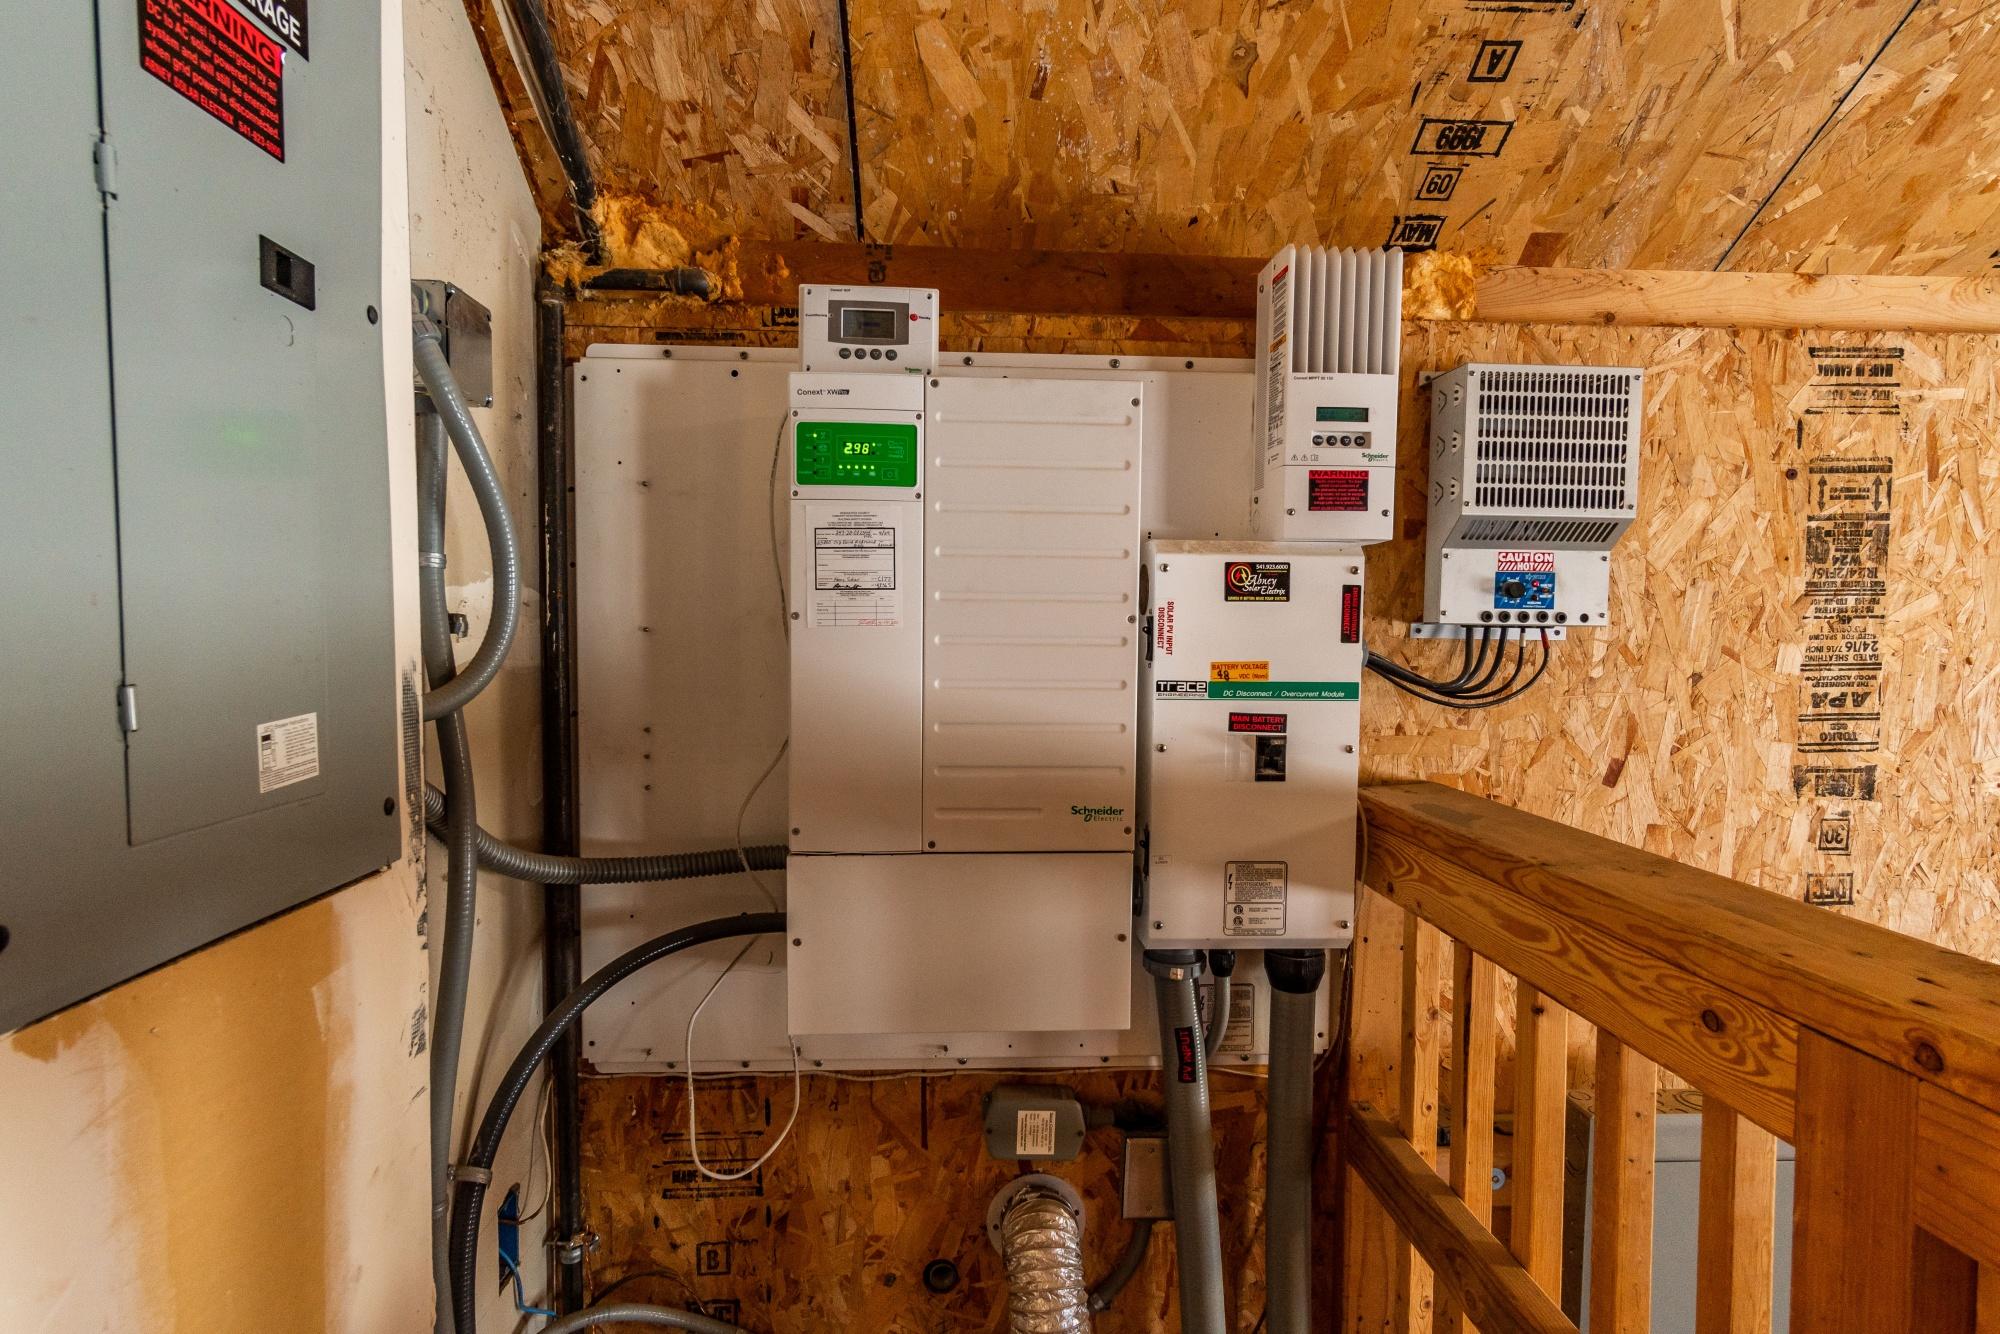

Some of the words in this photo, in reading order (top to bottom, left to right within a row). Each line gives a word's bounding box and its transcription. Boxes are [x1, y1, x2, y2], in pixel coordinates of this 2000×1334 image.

[183, 11, 206, 38] panel
[218, 39, 256, 76] energized
[190, 32, 211, 58] solar
[214, 53, 247, 85] powered
[249, 79, 276, 107] inverter
[1487, 49, 1507, 75] A
[146, 18, 178, 51] system
[181, 43, 197, 64] and
[244, 92, 278, 125] energized
[192, 71, 218, 97] power
[1435, 124, 1487, 150] 1999
[1393, 223, 1437, 242] MAY
[797, 388, 823, 396] Conext
[1499, 552, 1553, 562] CAUTION
[1517, 562, 1535, 570] HOT
[1157, 607, 1165, 649] DISCONNECT
[1166, 625, 1173, 633] PV
[1845, 640, 1879, 652] 24/16
[1804, 654, 1849, 662] SHEATHING
[1281, 690, 1319, 698] Overcurrent
[1811, 692, 1871, 708] APA
[1071, 805, 1124, 815] Schneider
[1180, 1031, 1192, 1063] INPUT
[1183, 1066, 1192, 1080] PV
[707, 1250, 719, 1270] B
